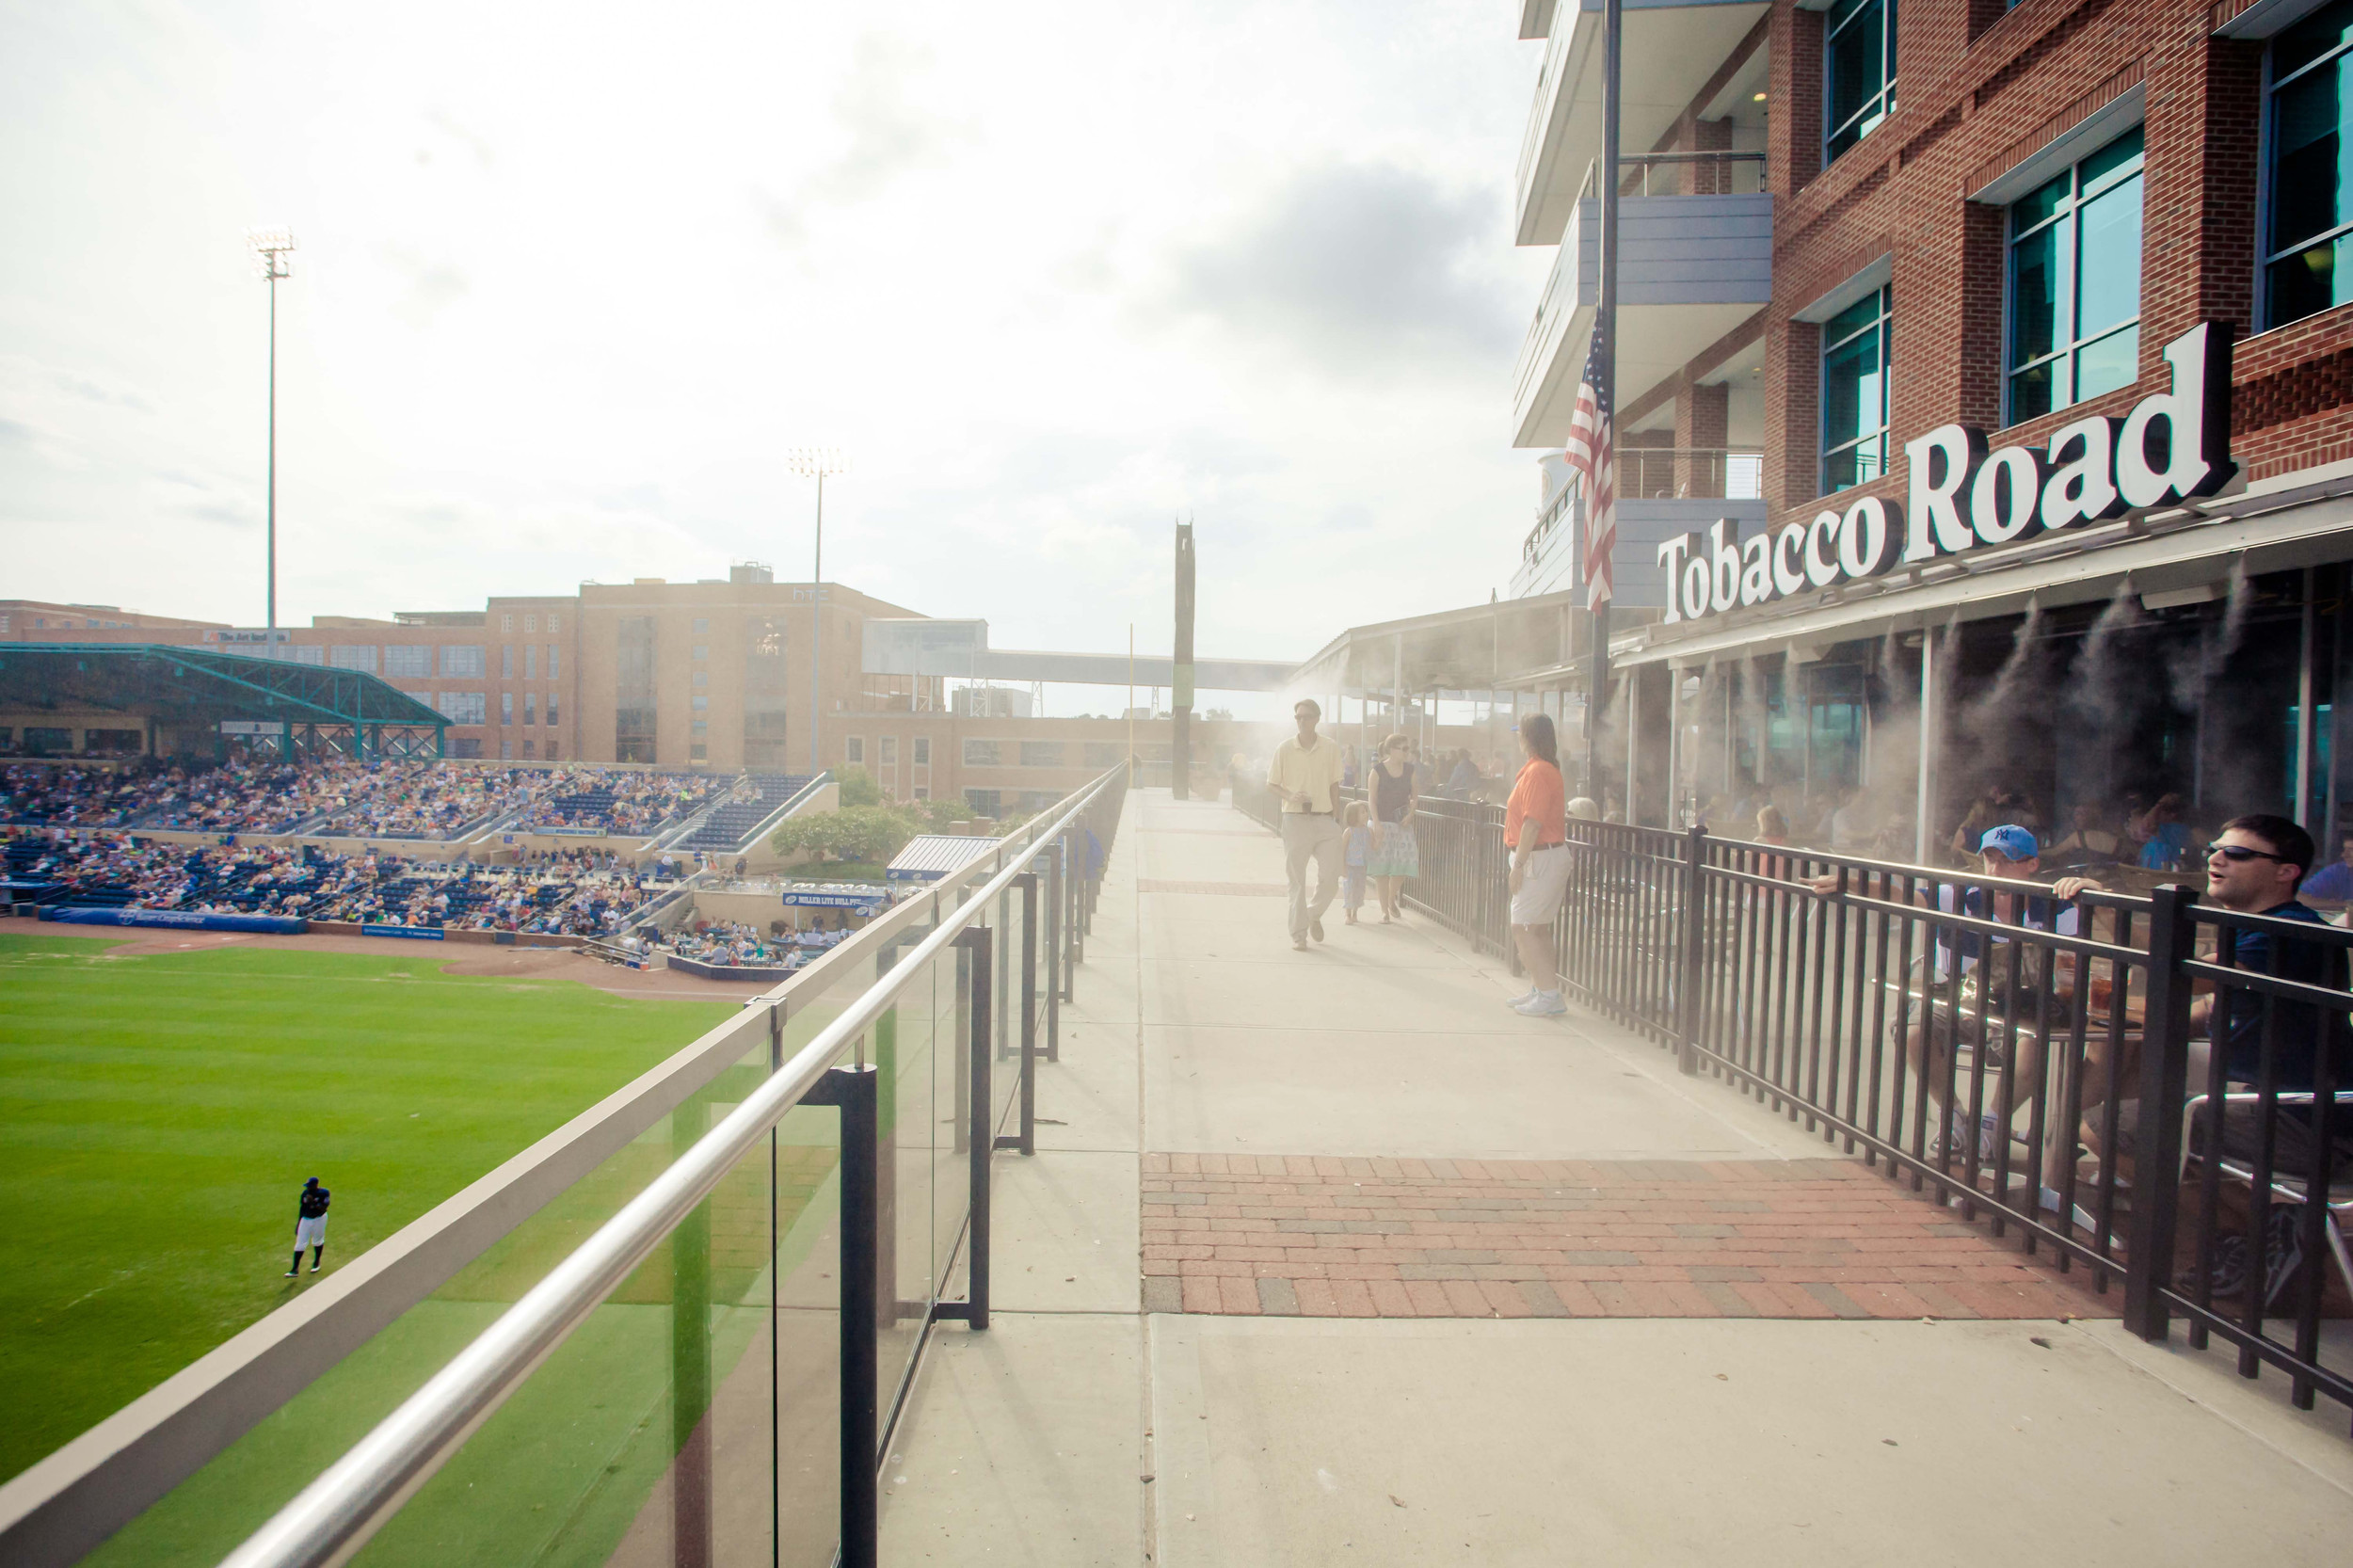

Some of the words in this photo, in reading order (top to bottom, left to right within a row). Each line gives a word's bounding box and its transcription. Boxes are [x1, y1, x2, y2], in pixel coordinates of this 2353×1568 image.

[1657, 496, 1892, 625] Tobacco
[1903, 321, 2217, 564] Road
[218, 632, 233, 641] The
[798, 895, 821, 904] MILLER
